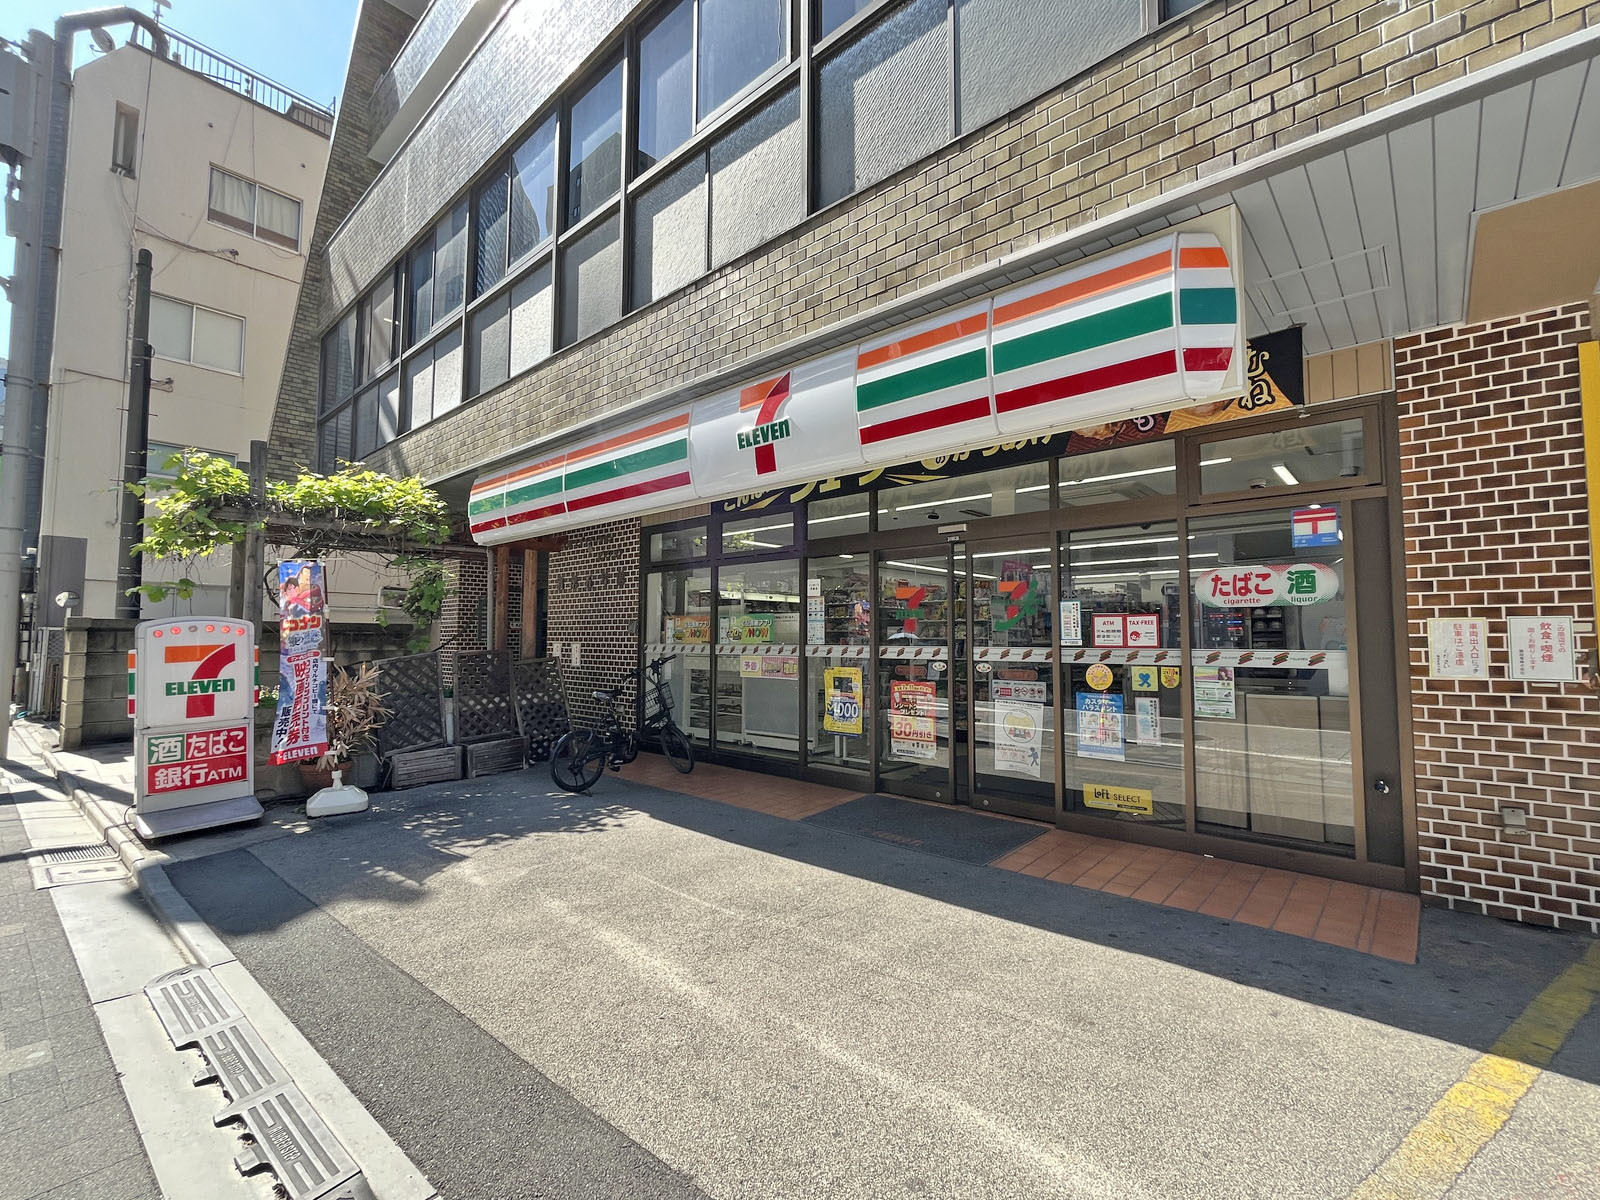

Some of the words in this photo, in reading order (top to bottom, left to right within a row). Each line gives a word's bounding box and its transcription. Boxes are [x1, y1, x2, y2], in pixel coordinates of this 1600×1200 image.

[737, 418, 791, 450] ELEVEN
[1211, 571, 1274, 597] たばこ
[1287, 569, 1316, 594] 酒
[1223, 597, 1262, 605] cigarette
[1540, 621, 1553, 662] 飲食・喫煙
[165, 678, 235, 697] ELEVEN
[150, 736, 183, 764] 酒
[187, 731, 245, 759] たばこ
[154, 763, 242, 790] 銀行ATM
[1113, 793, 1141, 803] SELECT
[267, 1125, 301, 1161] RUBBERSTEP
